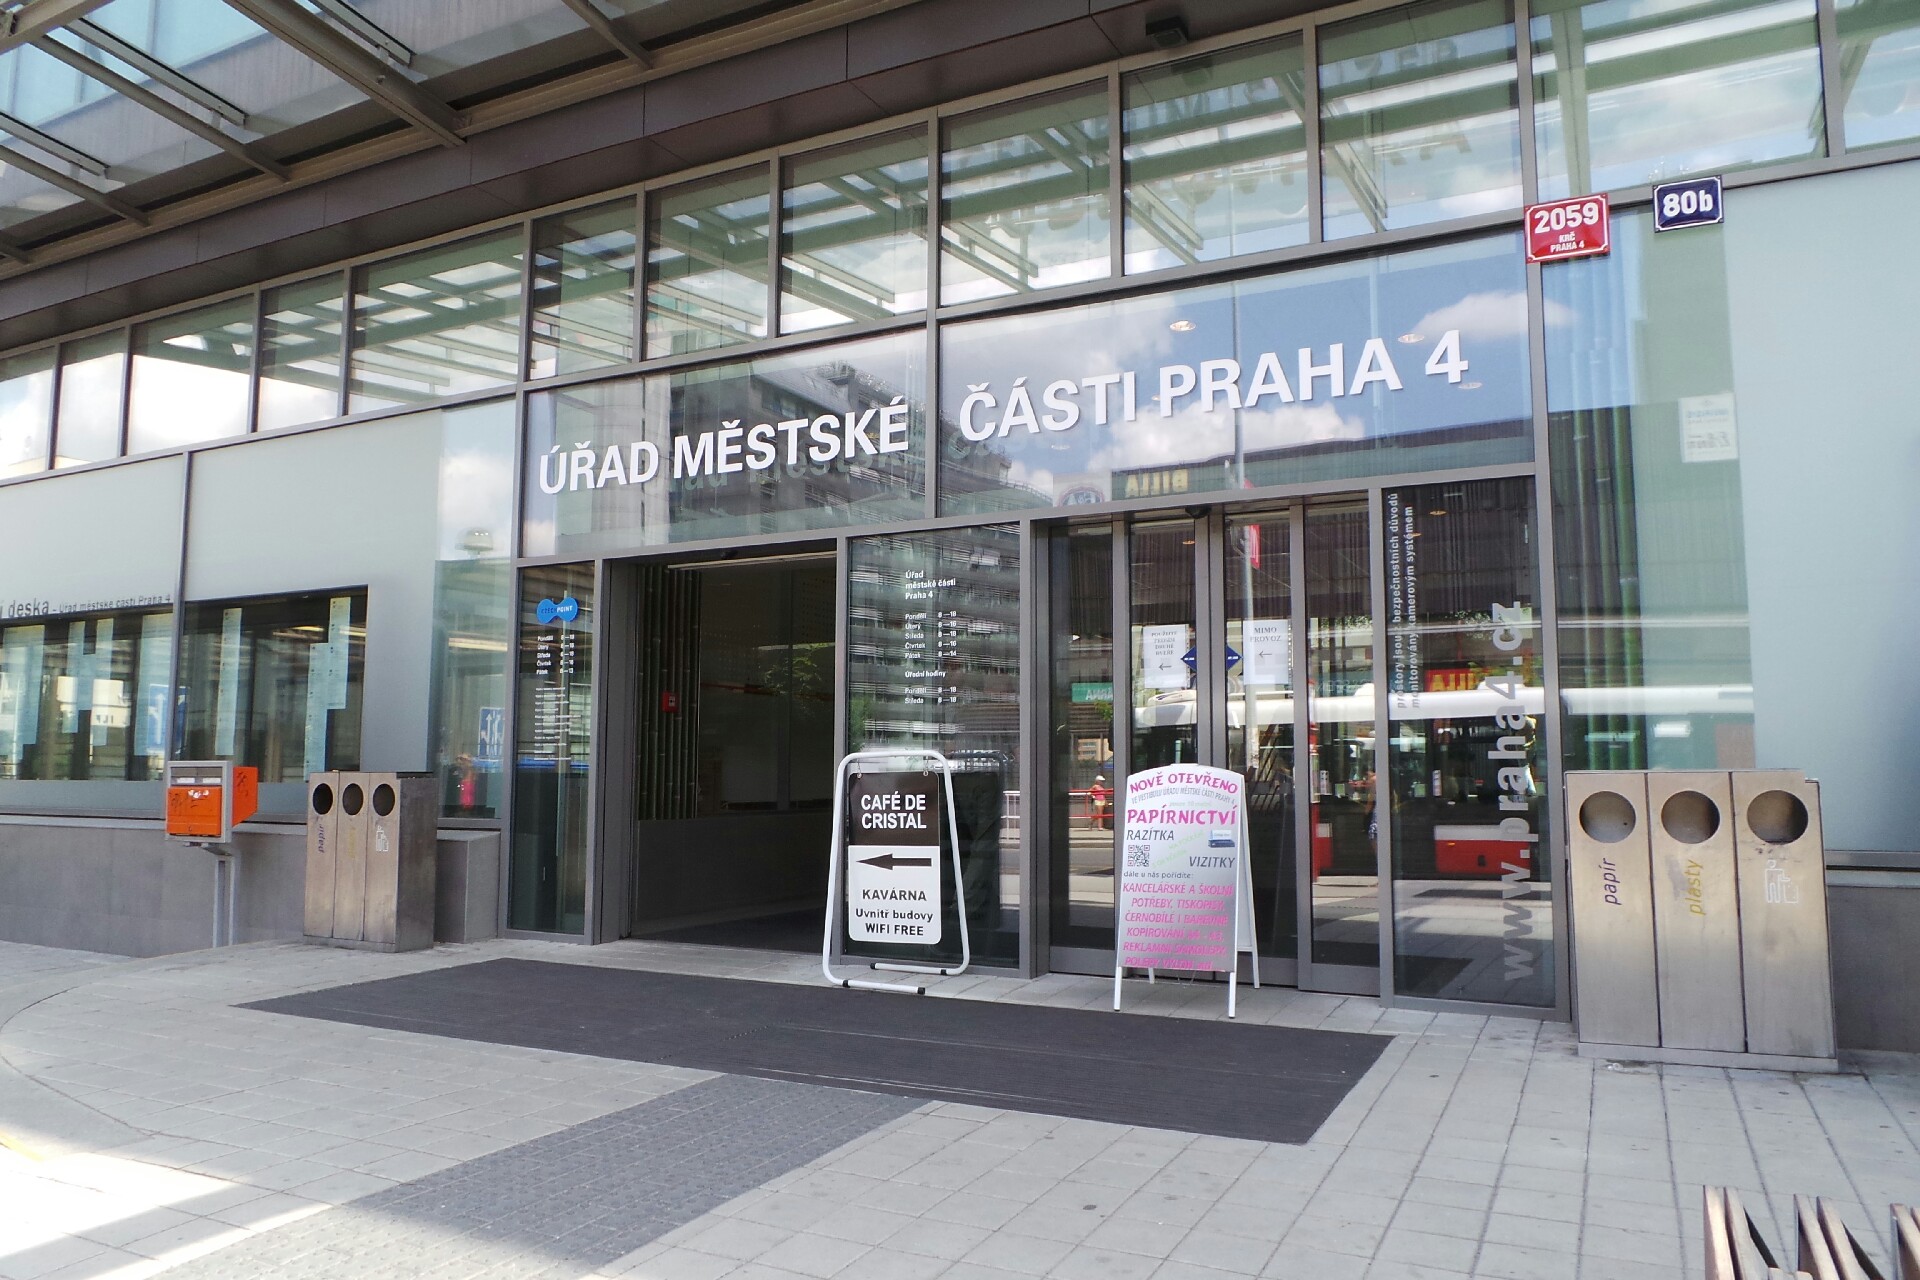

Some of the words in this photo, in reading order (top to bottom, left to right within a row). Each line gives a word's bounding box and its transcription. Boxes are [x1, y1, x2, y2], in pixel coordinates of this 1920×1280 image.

[1662, 189, 1714, 218] 80b
[1534, 202, 1599, 234] 2059
[1558, 231, 1576, 243] KRČ
[1550, 243, 1577, 253] PRAHA
[1578, 240, 1585, 249] 4
[539, 441, 659, 495] ÚŘAD
[673, 395, 910, 479] MĚSTSKÉ
[958, 370, 1137, 442] ČÁSTI
[1159, 337, 1402, 418] PRAHA
[1424, 329, 1469, 385] 4
[1387, 493, 1399, 533] důvodů
[1403, 506, 1416, 562] systémem
[905, 570, 924, 579] Úřad
[1390, 536, 1403, 623] bezpečnostních
[905, 580, 936, 590] městské
[938, 578, 956, 587] části
[905, 591, 927, 600] Praha
[928, 590, 934, 599] 4
[1404, 565, 1417, 629] kamerovým
[8, 597, 50, 619] deska
[1393, 635, 1405, 660] jsou
[926, 670, 946, 678] hodiny
[1407, 631, 1420, 709] monitorovány
[1129, 771, 1163, 793] NOVĚ
[1167, 771, 1238, 794] OTEVŘENO
[1484, 601, 1539, 981] www.praha4.cz
[860, 791, 901, 811] CAFÉ
[904, 794, 927, 811] DE
[1180, 785, 1200, 796] MĚSTSKÉ
[1214, 792, 1231, 804] PRAHY
[861, 812, 927, 829] CRISTAL
[1127, 804, 1238, 825] PAPÍRNICTVÍ
[1126, 827, 1174, 841] RAZÍTKA
[1189, 856, 1236, 869] VIZITKY
[1161, 871, 1194, 879] pořídíte:
[1598, 857, 1623, 906] papír
[862, 887, 927, 902] KAVÁRNA
[1122, 881, 1186, 894] KANCELÁŘSKÉ
[1189, 885, 1195, 894] A
[1198, 883, 1234, 896] ŠKOLNÍ
[1683, 859, 1707, 916] plasty
[855, 908, 890, 920] Uvnitř
[892, 909, 933, 923] budovy
[1124, 910, 1175, 924] ČERNOBÍLÉ
[865, 922, 890, 935] WIFI
[894, 923, 924, 936] FREE
[1126, 926, 1185, 938] KOPÍROVÁNÍ
[1122, 941, 1172, 953] REKLAMNÍ
